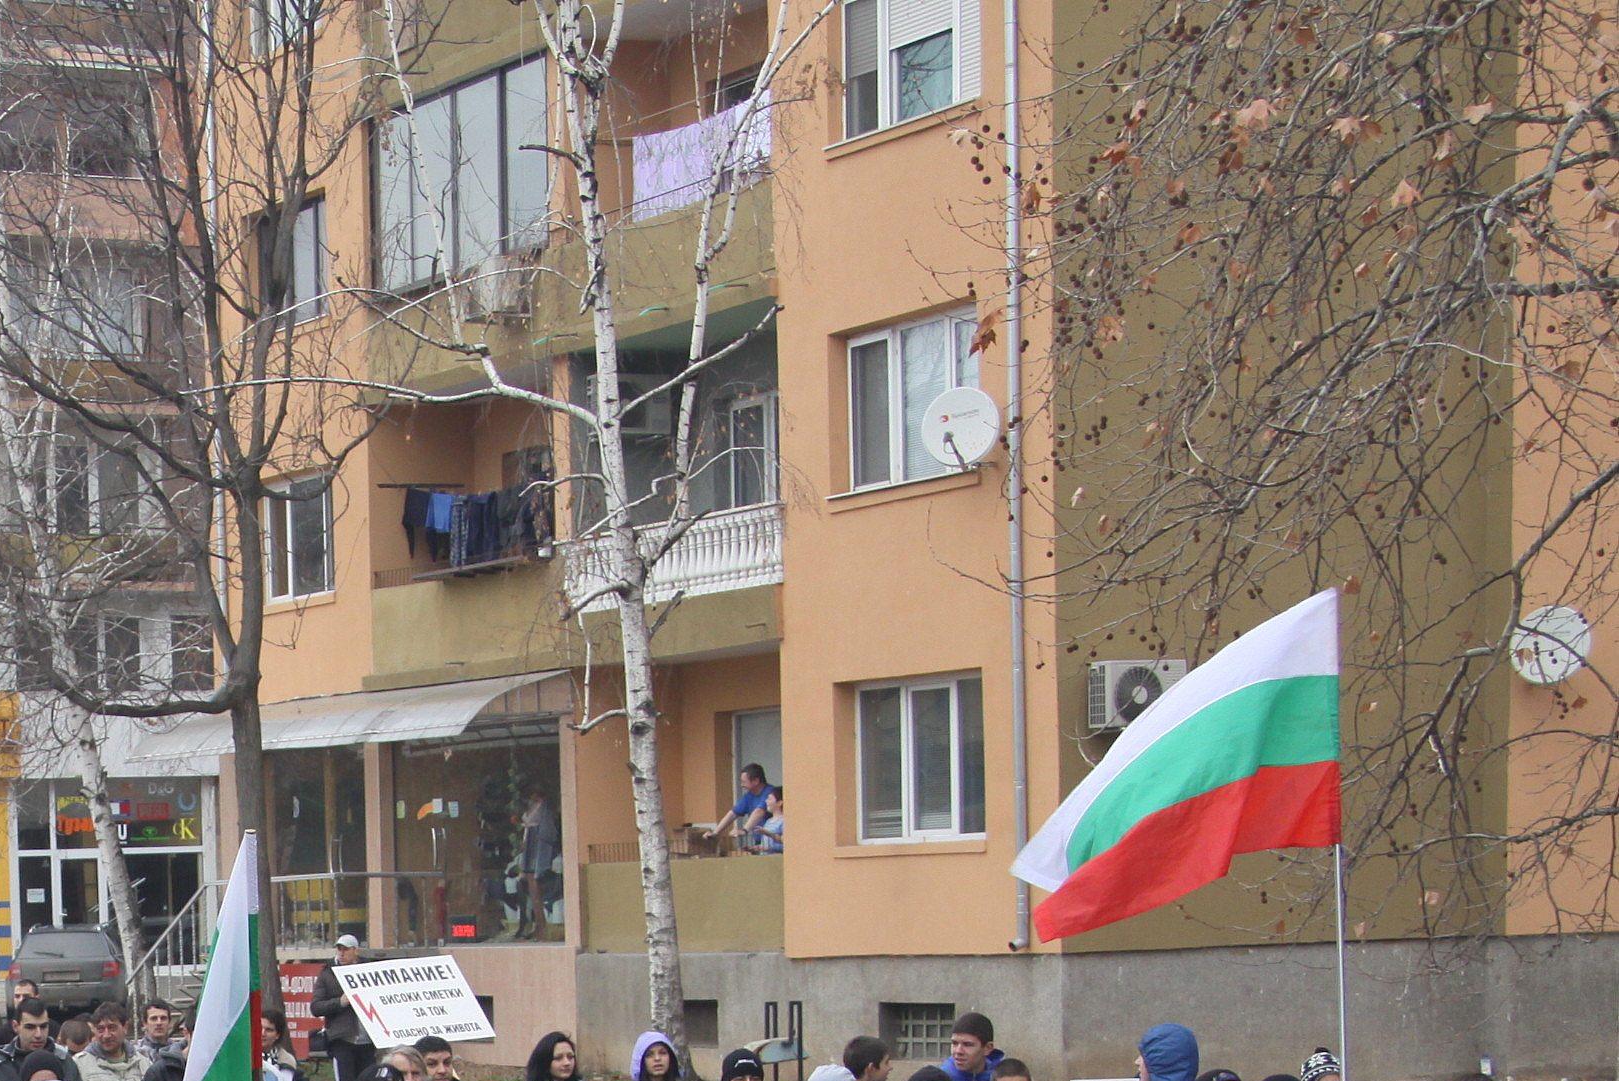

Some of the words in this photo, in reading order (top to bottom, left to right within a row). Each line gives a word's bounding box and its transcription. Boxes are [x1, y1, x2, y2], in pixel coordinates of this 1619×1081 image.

[344, 964, 457, 989] ВНИМАНИЕ!
[379, 991, 423, 1006] ВИСОКИ
[423, 987, 465, 1001] СМЕТКИ
[412, 1006, 427, 1018] ЗА
[429, 1005, 449, 1017] ТОК
[393, 1026, 430, 1039] ОПАСНО
[431, 1025, 443, 1036] ЗА
[444, 1022, 483, 1034] ЖИВОТА
